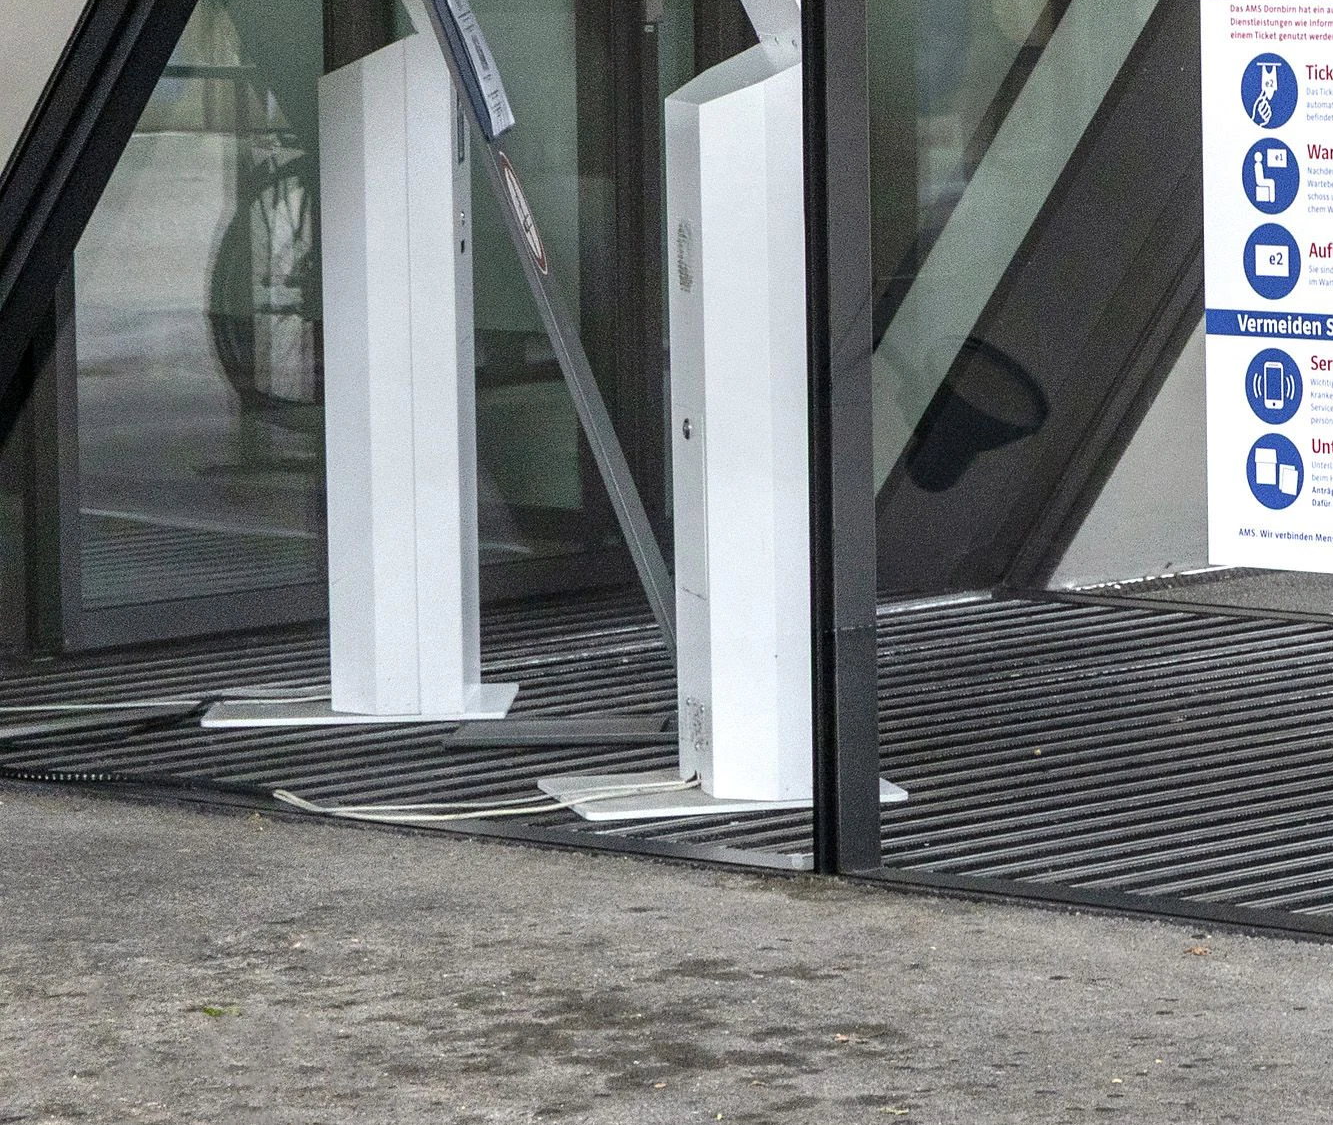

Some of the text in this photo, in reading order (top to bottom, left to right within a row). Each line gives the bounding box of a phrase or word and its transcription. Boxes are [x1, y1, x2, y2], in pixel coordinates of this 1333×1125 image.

[1229, 4, 1243, 12] Das
[1245, 4, 1261, 12] AMS
[1263, 4, 1296, 13] Dornbirn
[1298, 5, 1311, 13] hat
[1229, 17, 1292, 28] Dienstleistungen
[1230, 31, 1253, 39] einem
[1254, 31, 1276, 39] Ticket
[1278, 32, 1307, 41] genutzt
[1265, 79, 1274, 88] e2
[1275, 153, 1284, 162] e1
[1269, 252, 1284, 266] e2
[1237, 313, 1321, 335] Vermeiden
[1311, 498, 1330, 507] Dafür
[1238, 528, 1257, 537] AMS.
[1259, 529, 1272, 538] Wir
[1274, 530, 1313, 540] verbinden
